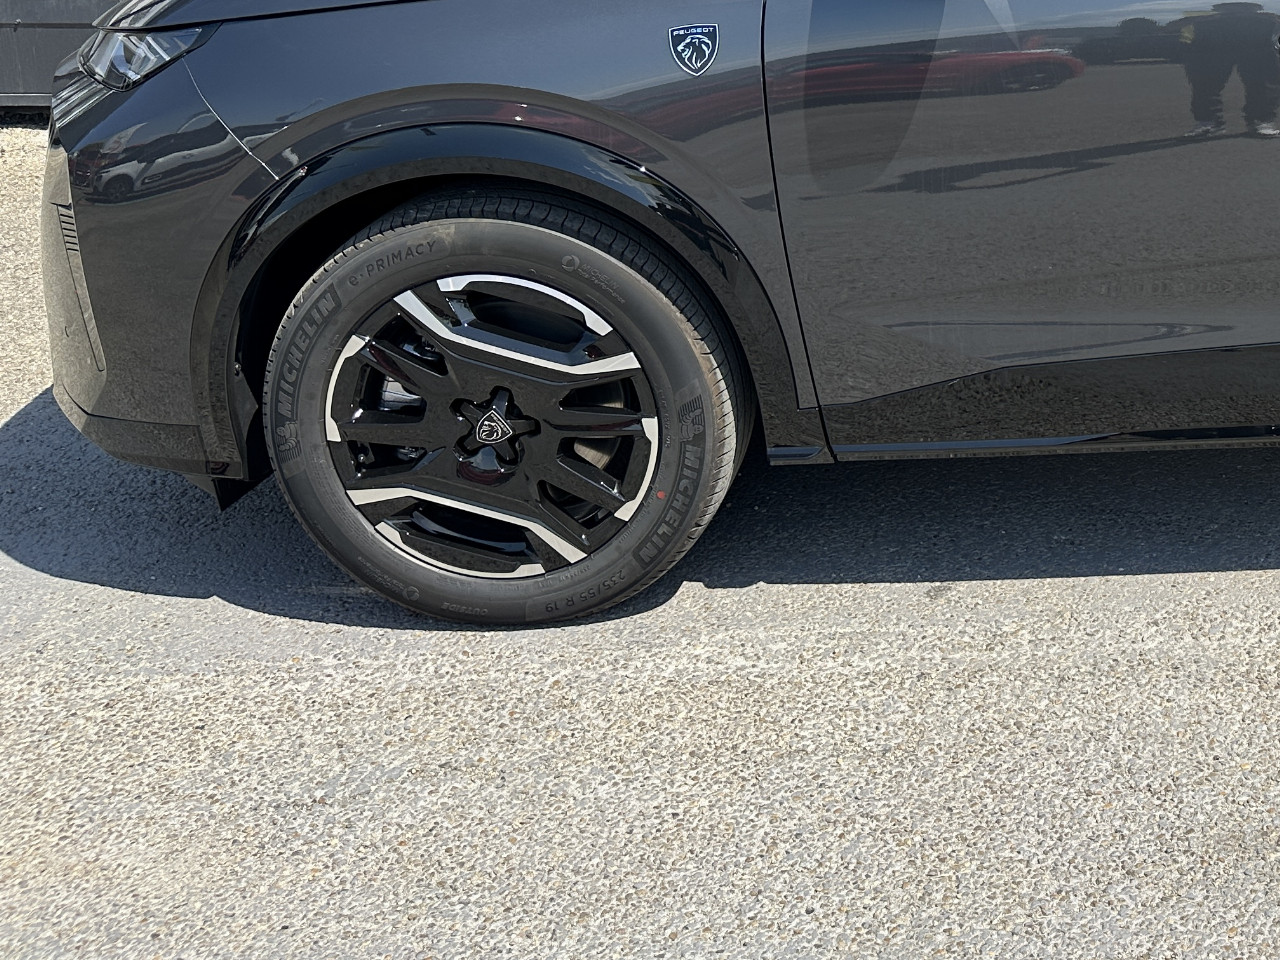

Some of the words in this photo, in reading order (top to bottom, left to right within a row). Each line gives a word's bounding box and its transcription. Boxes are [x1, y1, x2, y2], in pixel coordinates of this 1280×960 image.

[673, 27, 714, 36] PEUGEOT
[277, 296, 338, 420] MICHELIN
[639, 445, 700, 565] MICHELIN
[440, 602, 489, 616] OUTSIDE
